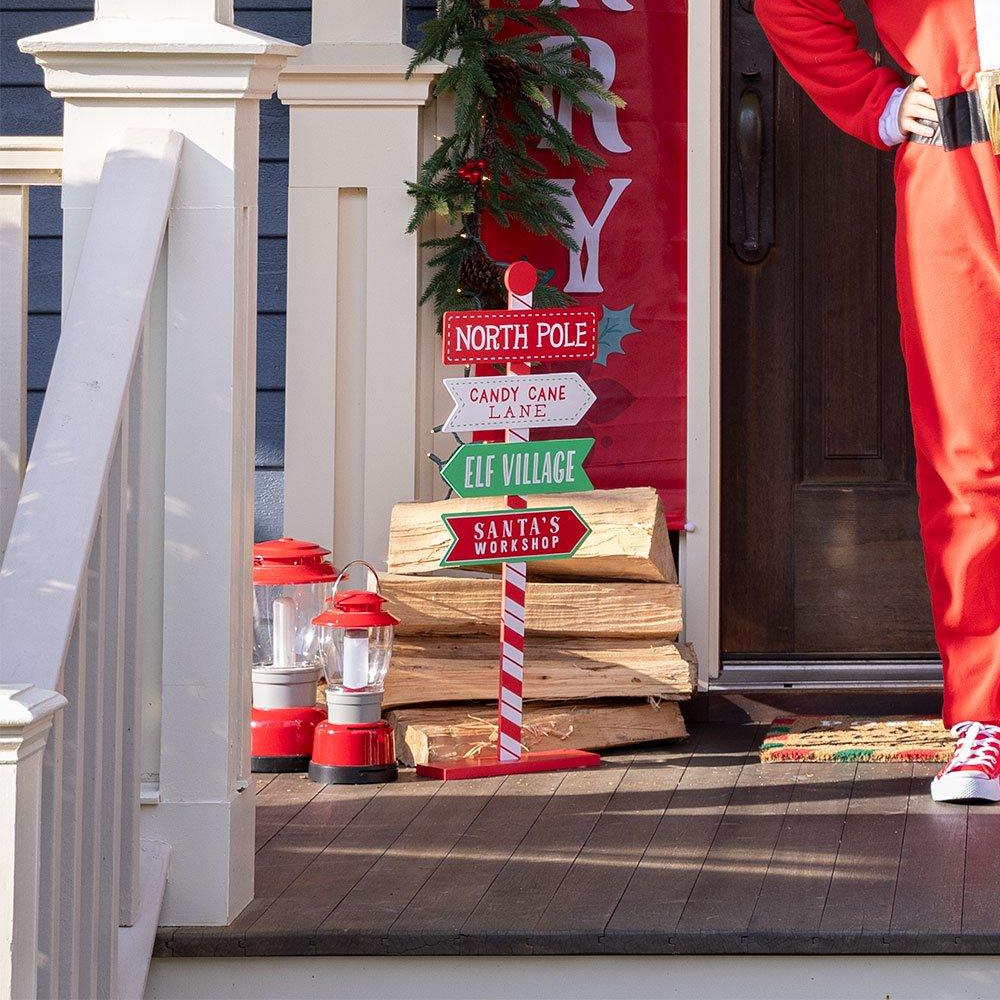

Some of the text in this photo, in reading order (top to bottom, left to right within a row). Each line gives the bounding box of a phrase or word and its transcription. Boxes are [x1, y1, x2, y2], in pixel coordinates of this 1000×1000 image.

[455, 321, 587, 351] NORTH POLE
[469, 385, 566, 403] CANDY CANE
[489, 404, 546, 419] LANE
[464, 450, 576, 488] ELF VILLAGE
[474, 516, 560, 539] SANTA'S
[474, 536, 560, 555] WORKSHOP
